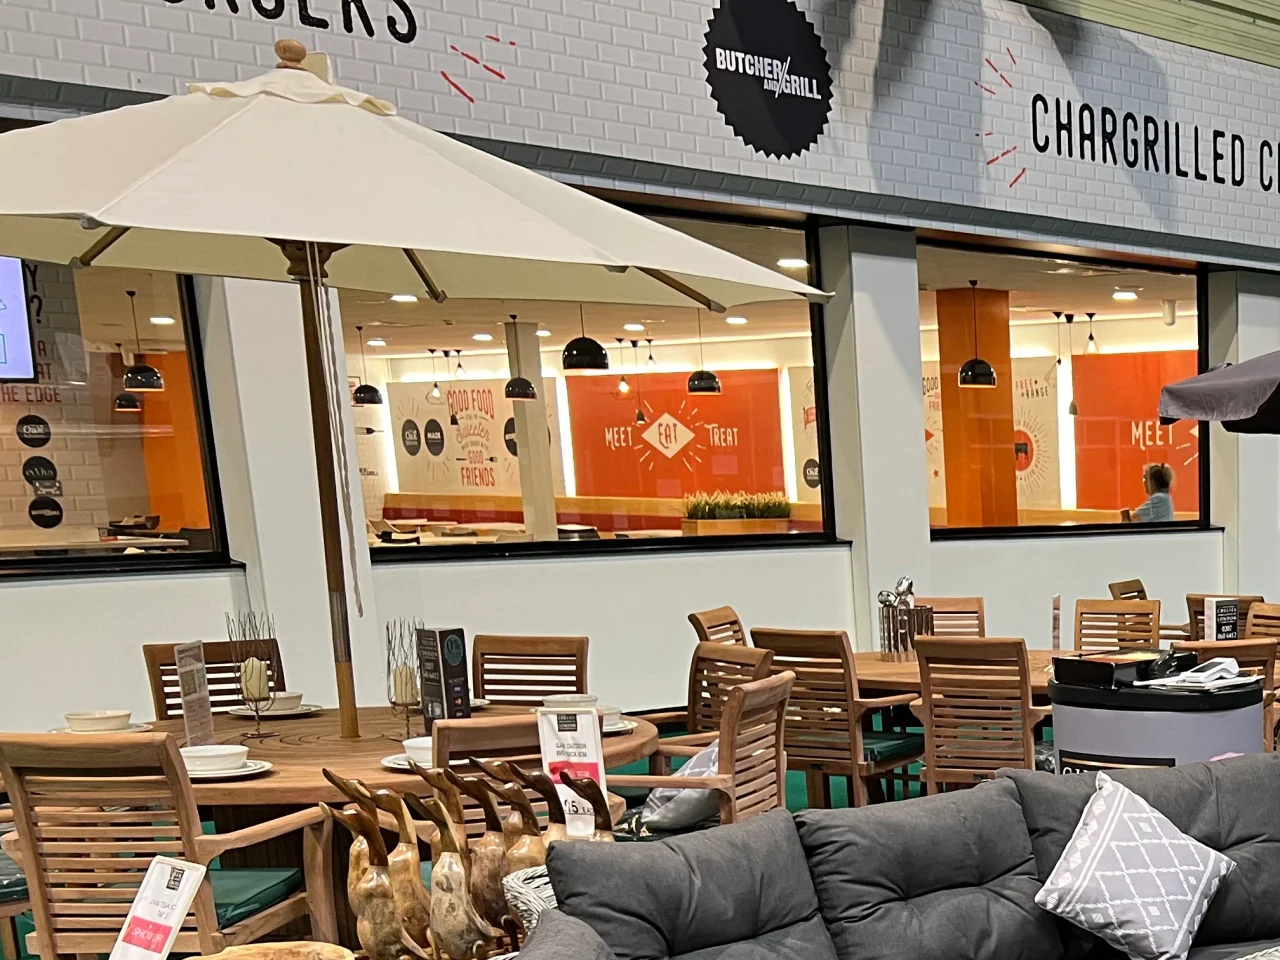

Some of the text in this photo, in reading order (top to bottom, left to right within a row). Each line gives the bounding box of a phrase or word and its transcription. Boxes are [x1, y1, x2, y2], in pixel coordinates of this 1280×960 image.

[715, 47, 782, 80] BUTCHER
[763, 72, 822, 100] AND GRILL
[1032, 93, 1245, 187] CHARGRILLED
[0, 387, 62, 404] HE EDGE
[447, 389, 495, 420] GOOD FOOD
[1026, 386, 1049, 400] RANGE
[605, 423, 738, 450] MEET EAT TREAT
[461, 467, 495, 487] FRIENDS
